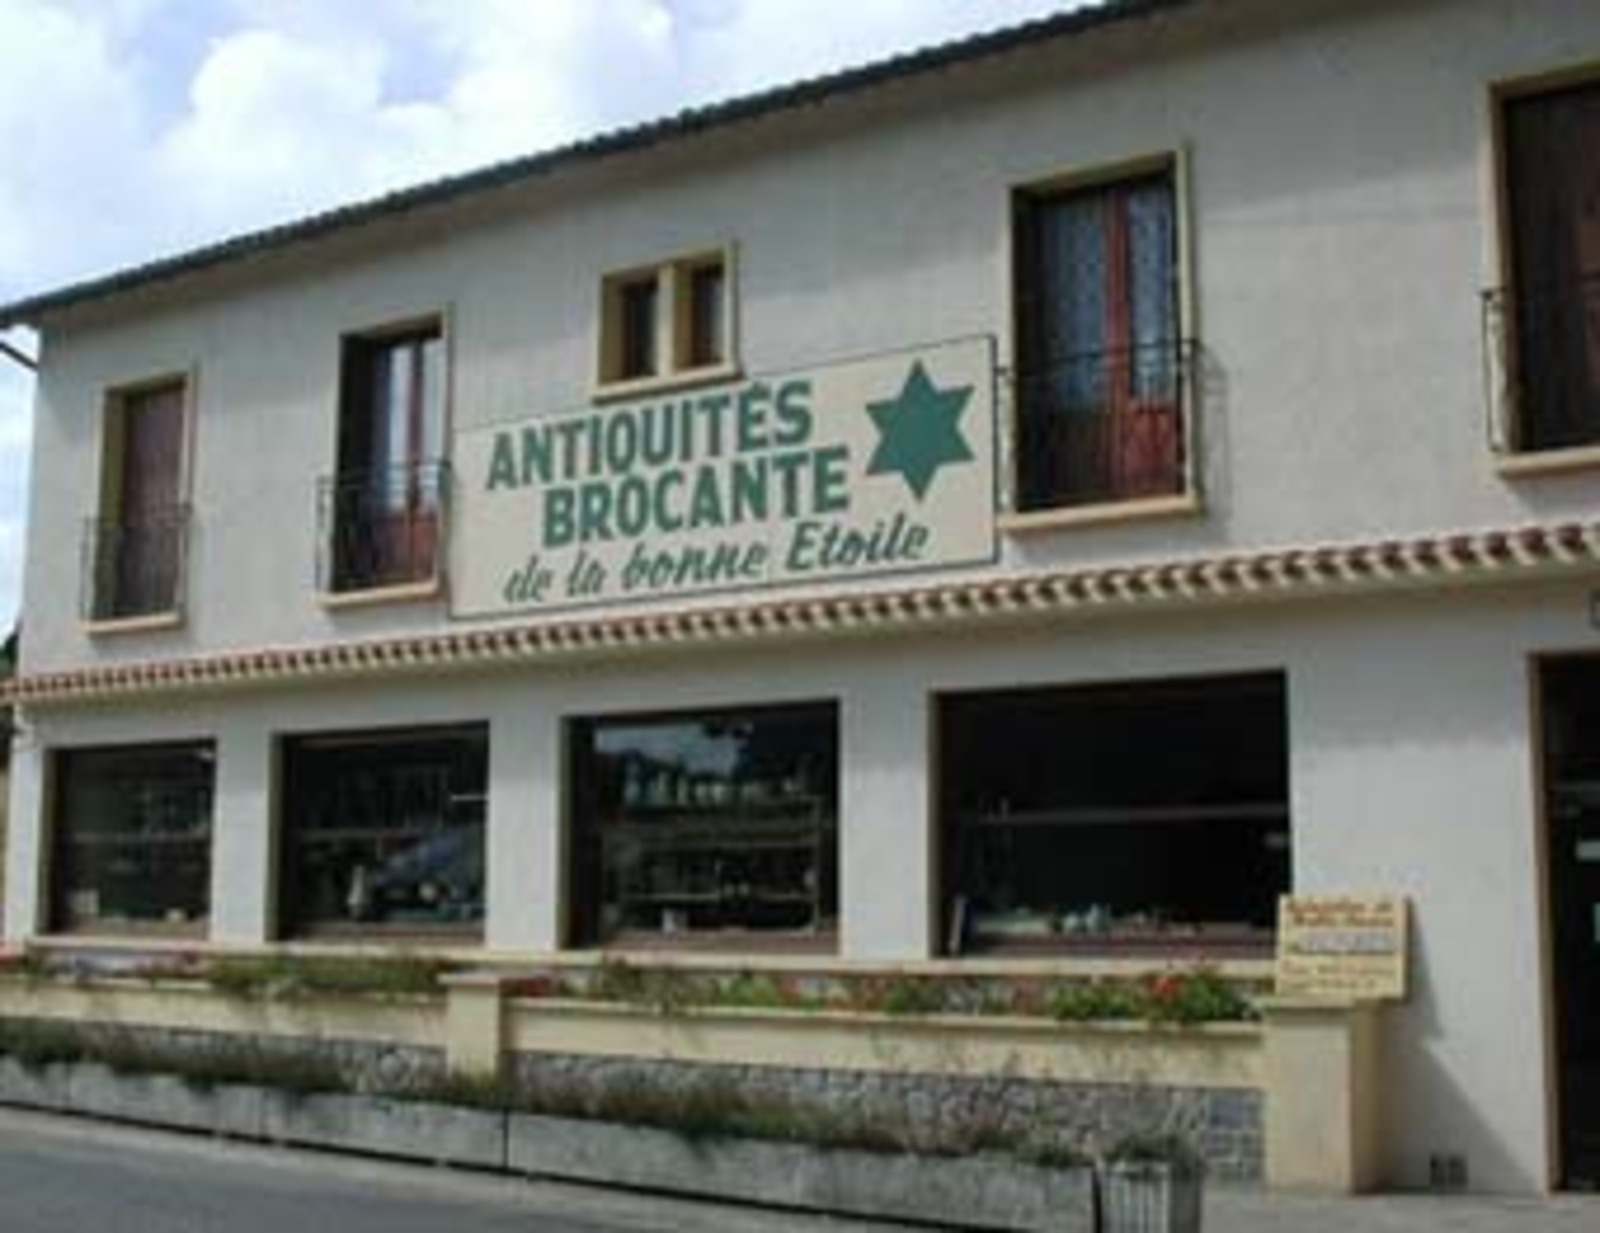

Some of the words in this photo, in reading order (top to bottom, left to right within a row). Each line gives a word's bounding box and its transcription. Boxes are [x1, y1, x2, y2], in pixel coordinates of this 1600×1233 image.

[543, 446, 849, 548] BROCANTE
[504, 556, 550, 603] de
[566, 548, 605, 597] la
[623, 543, 765, 589] bonne
[787, 513, 929, 571] Etoile
